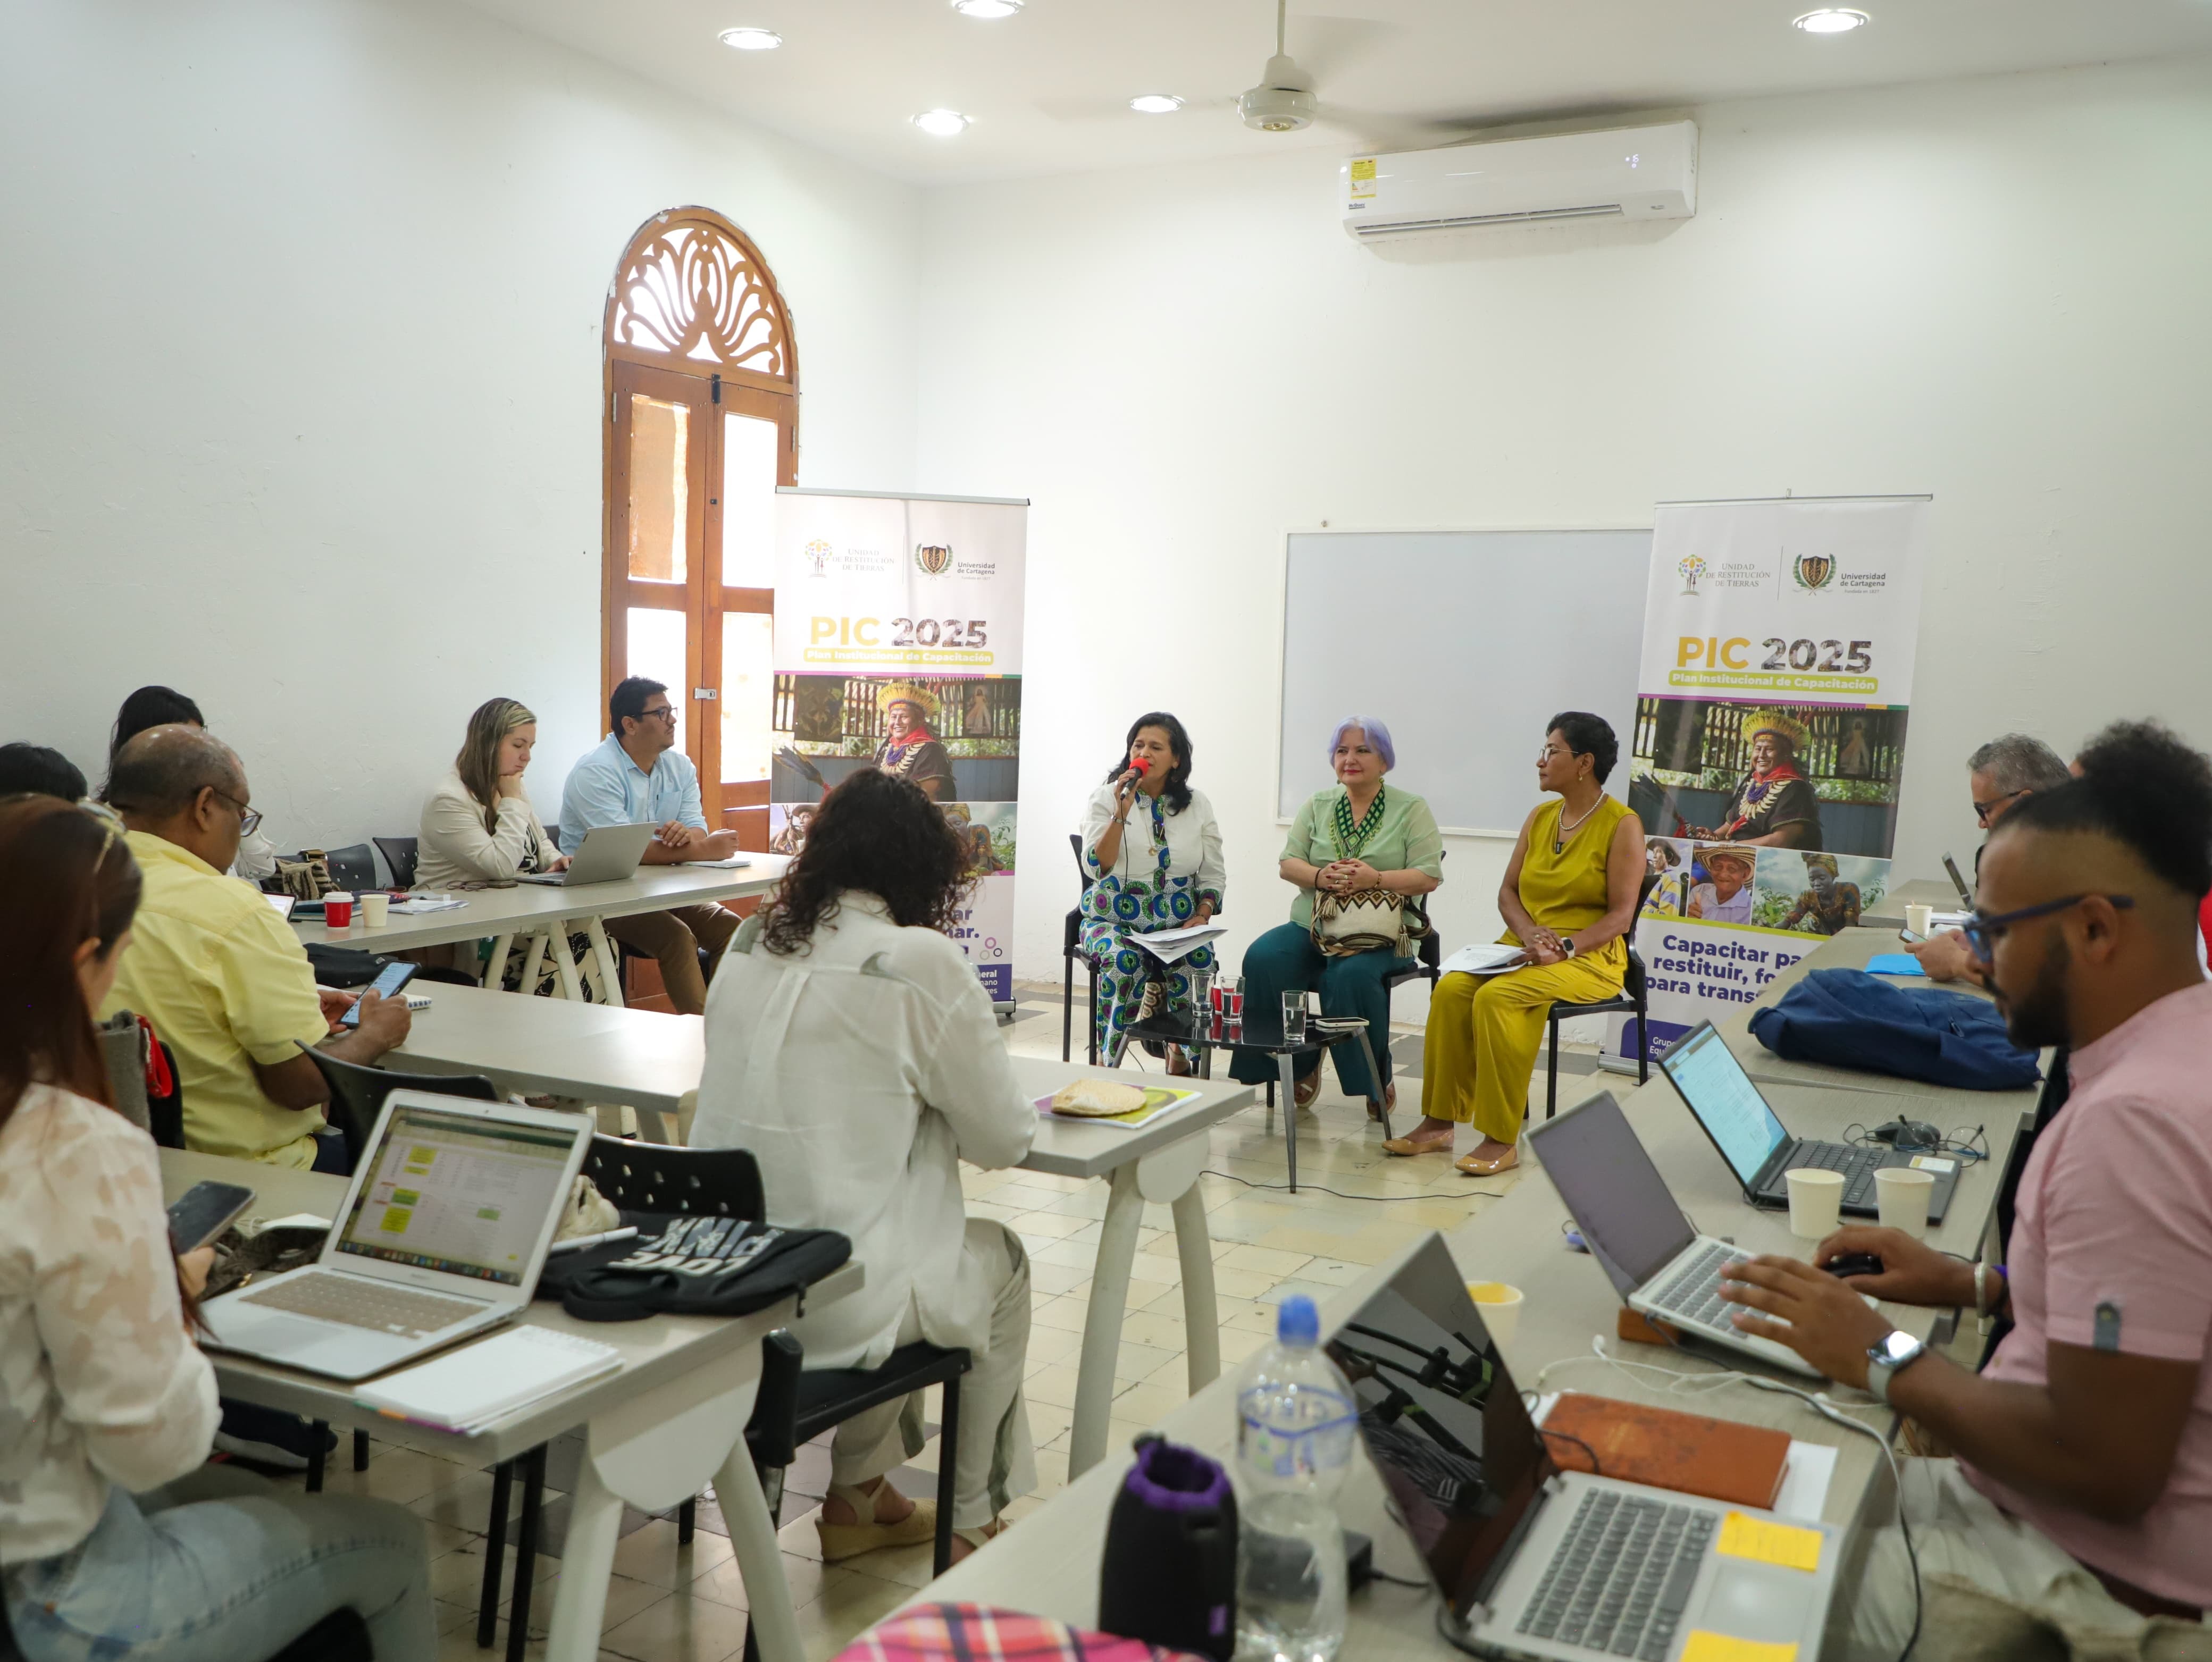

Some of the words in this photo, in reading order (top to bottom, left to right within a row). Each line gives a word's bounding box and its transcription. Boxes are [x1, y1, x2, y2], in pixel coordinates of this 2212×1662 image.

[844, 555, 894, 564] RESTITUCIÓN
[1717, 570, 1771, 578] RESTITUCIÓN
[810, 616, 881, 647] PIC
[891, 618, 987, 649] 2025
[807, 650, 831, 660] Plan
[834, 650, 903, 661] Institucional
[906, 652, 919, 661] de
[923, 652, 991, 664] Capacitación
[1677, 637, 1751, 669] PIC
[1761, 638, 1872, 674] 2025
[1672, 673, 1697, 683] Plan
[1699, 674, 1773, 686] Institucional
[1777, 676, 1791, 686] de
[1794, 678, 1875, 690] Capacitación
[1663, 935, 1769, 963] Capacitar
[1775, 952, 1802, 969] pa
[1653, 956, 1748, 985] restituir,
[1755, 968, 1776, 984] fo
[1697, 982, 1759, 1004] trans
[1649, 1045, 1666, 1056] Equ
[638, 1216, 785, 1258] PINK
[608, 1250, 751, 1277] LOVE
